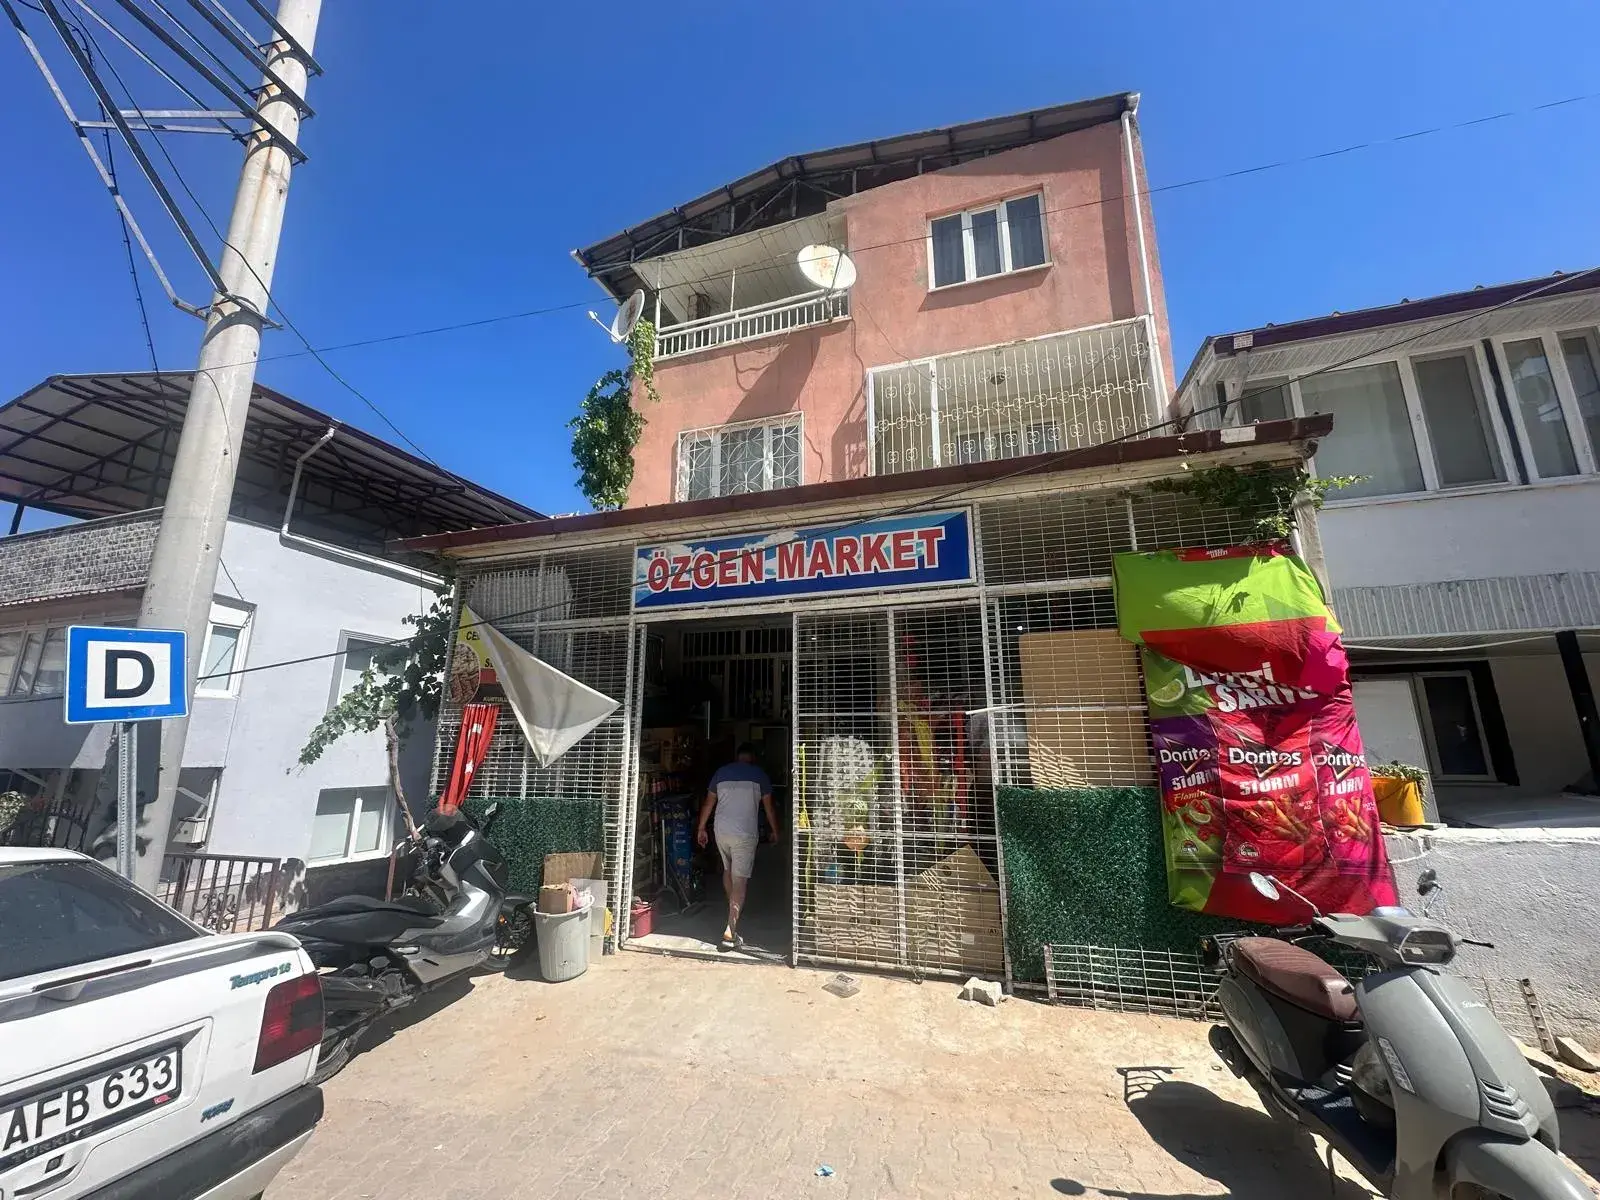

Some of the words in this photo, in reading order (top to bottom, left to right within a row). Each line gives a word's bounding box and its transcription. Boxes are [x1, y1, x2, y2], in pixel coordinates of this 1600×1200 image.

[648, 546, 766, 593] ÖZGEN
[775, 525, 946, 582] MARKET
[105, 649, 155, 699] D
[1159, 747, 1218, 763] Doritos
[1229, 747, 1301, 765] Doritos
[1313, 752, 1366, 767] Doritos
[1240, 773, 1300, 796] STORM
[3, 1084, 90, 1151] AFB
[103, 1055, 173, 1109] 633
